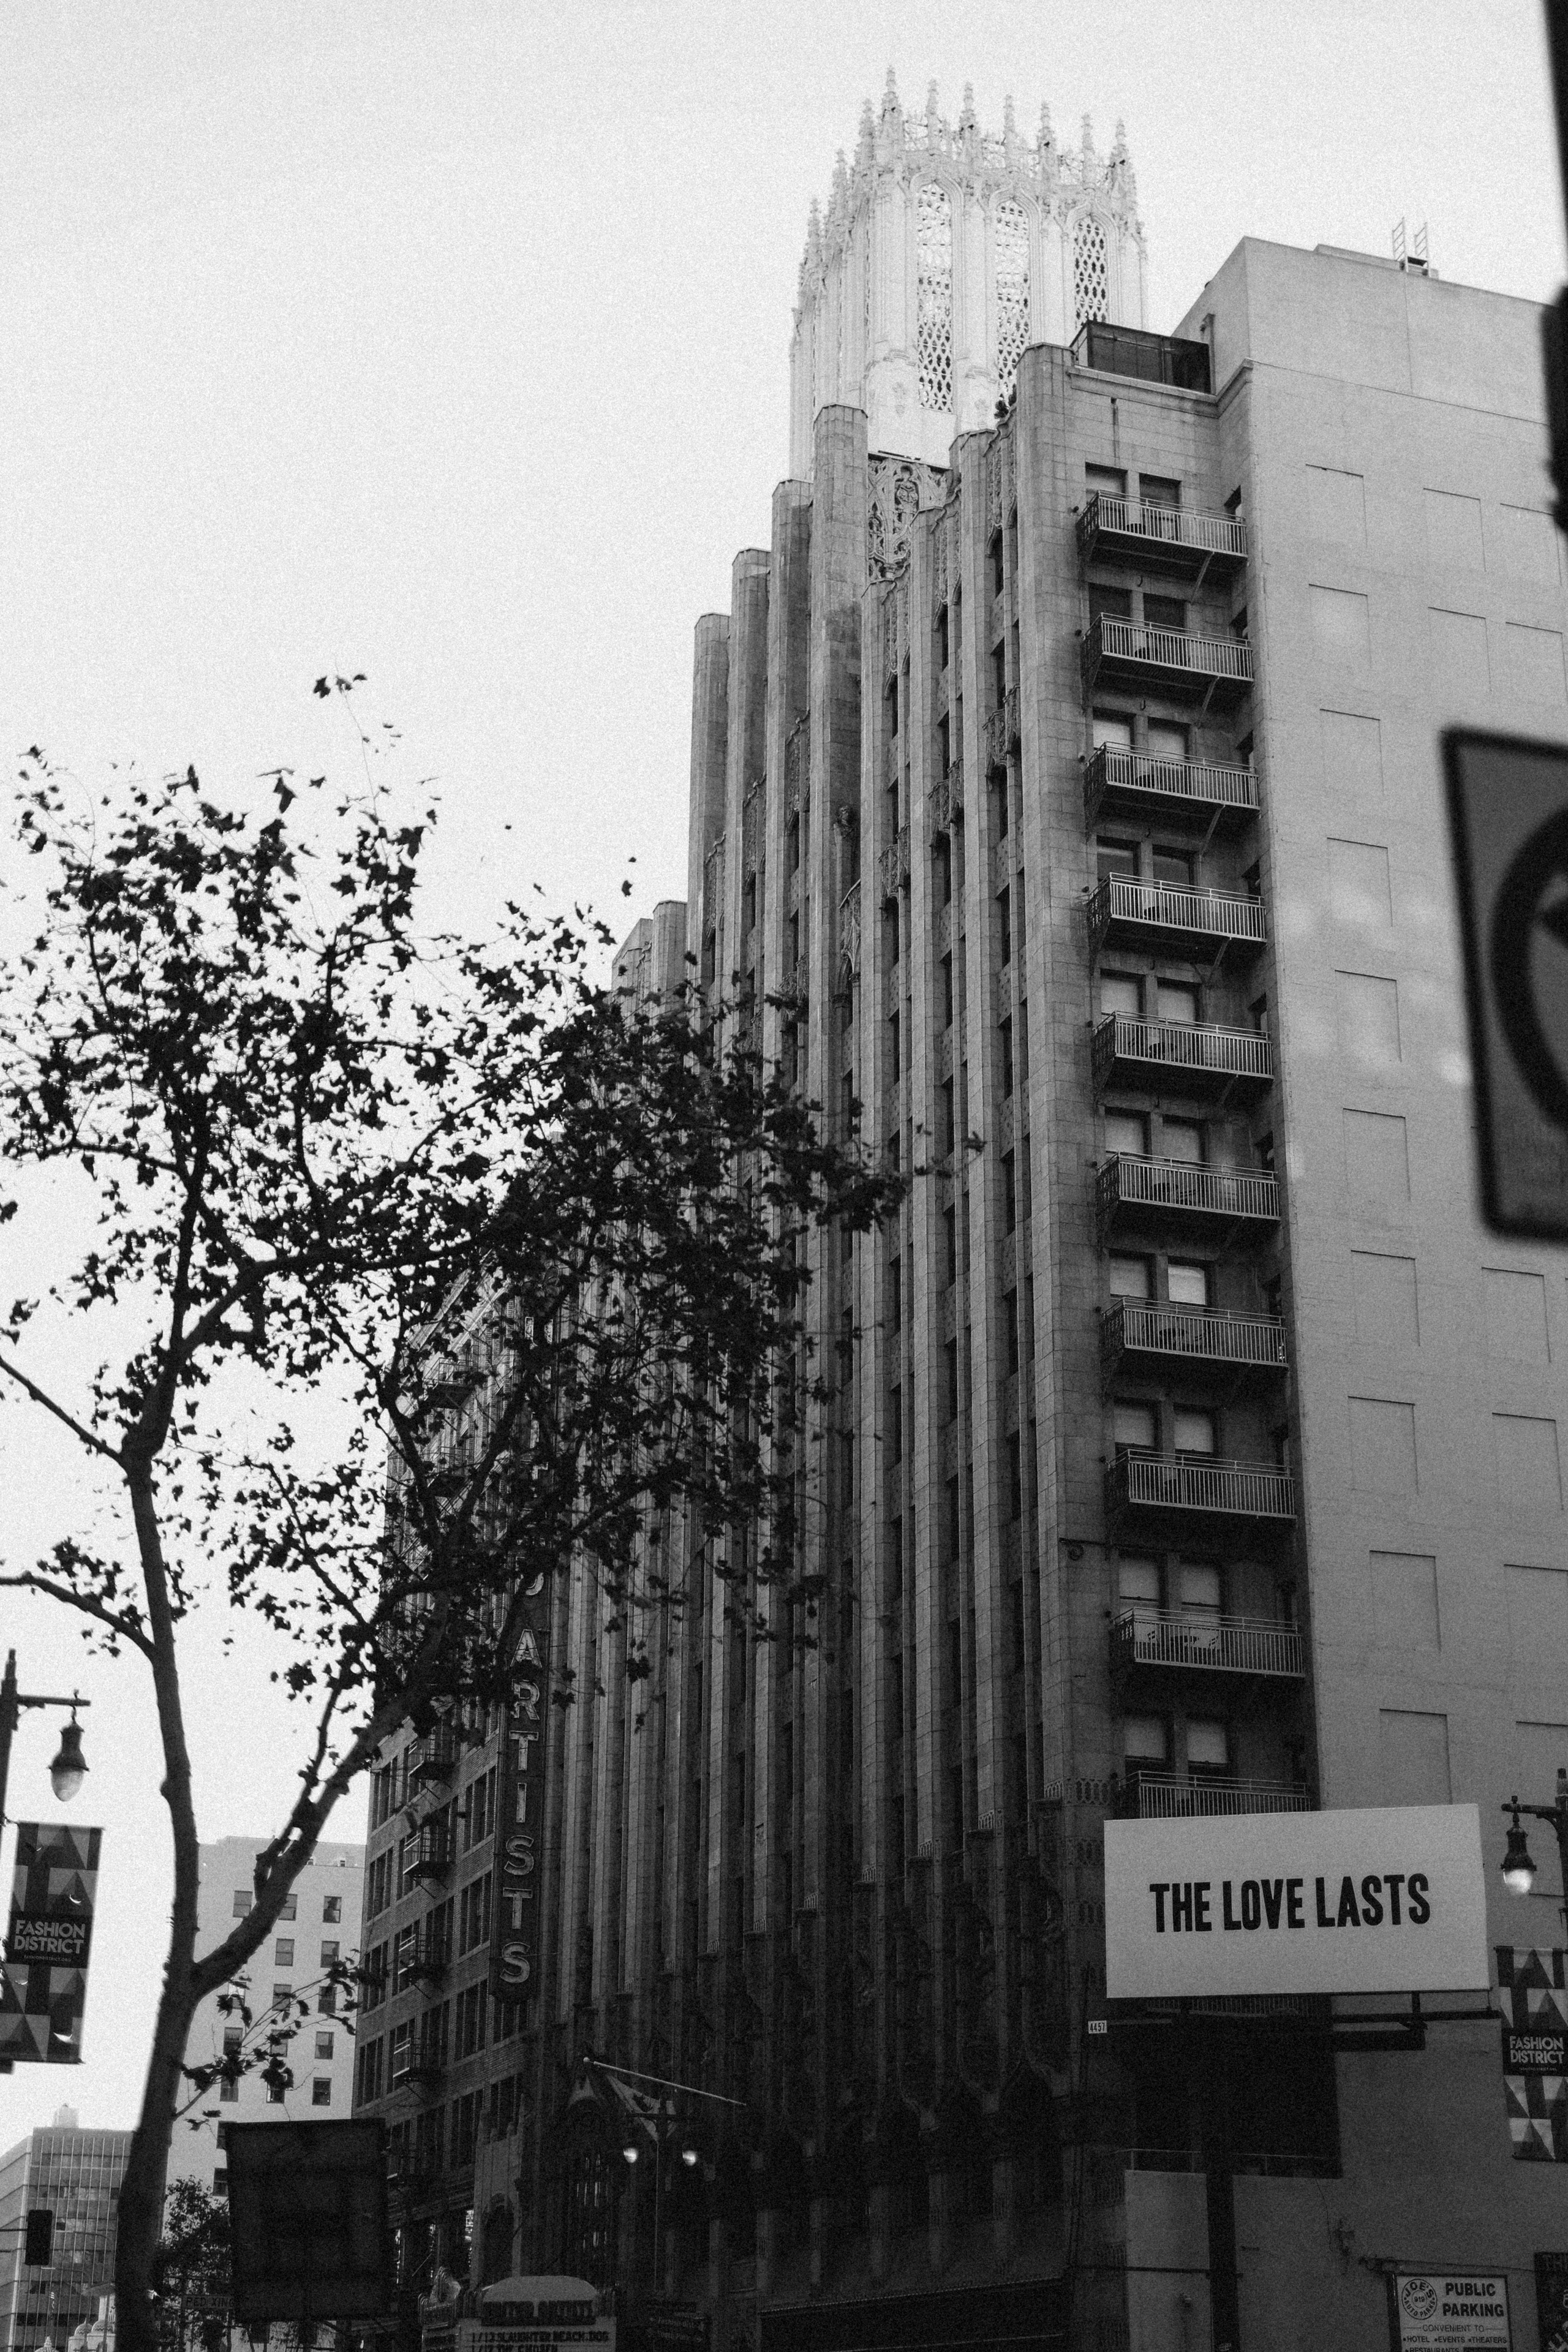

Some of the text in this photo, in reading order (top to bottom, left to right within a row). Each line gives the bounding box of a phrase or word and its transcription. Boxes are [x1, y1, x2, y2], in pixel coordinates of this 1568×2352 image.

[499, 1629, 543, 1983] ARTISTS
[1149, 1873, 1431, 1933] THE LOVE LASTS
[15, 1920, 85, 1939] FASHION
[14, 1935, 85, 1954] DISTRICT
[1090, 2022, 1105, 2032] 4457
[1509, 2035, 1564, 2050] FASHION
[1510, 2049, 1565, 2064] DISTRICT
[1404, 2281, 1434, 2298] JOE'S
[1445, 2282, 1496, 2297] PUBLIC
[186, 2297, 206, 2307] PED
[1404, 2300, 1435, 2317] AUTO PARKS
[1442, 2302, 1504, 2318] PARKING
[497, 2331, 551, 2343] SLAUGHTER
